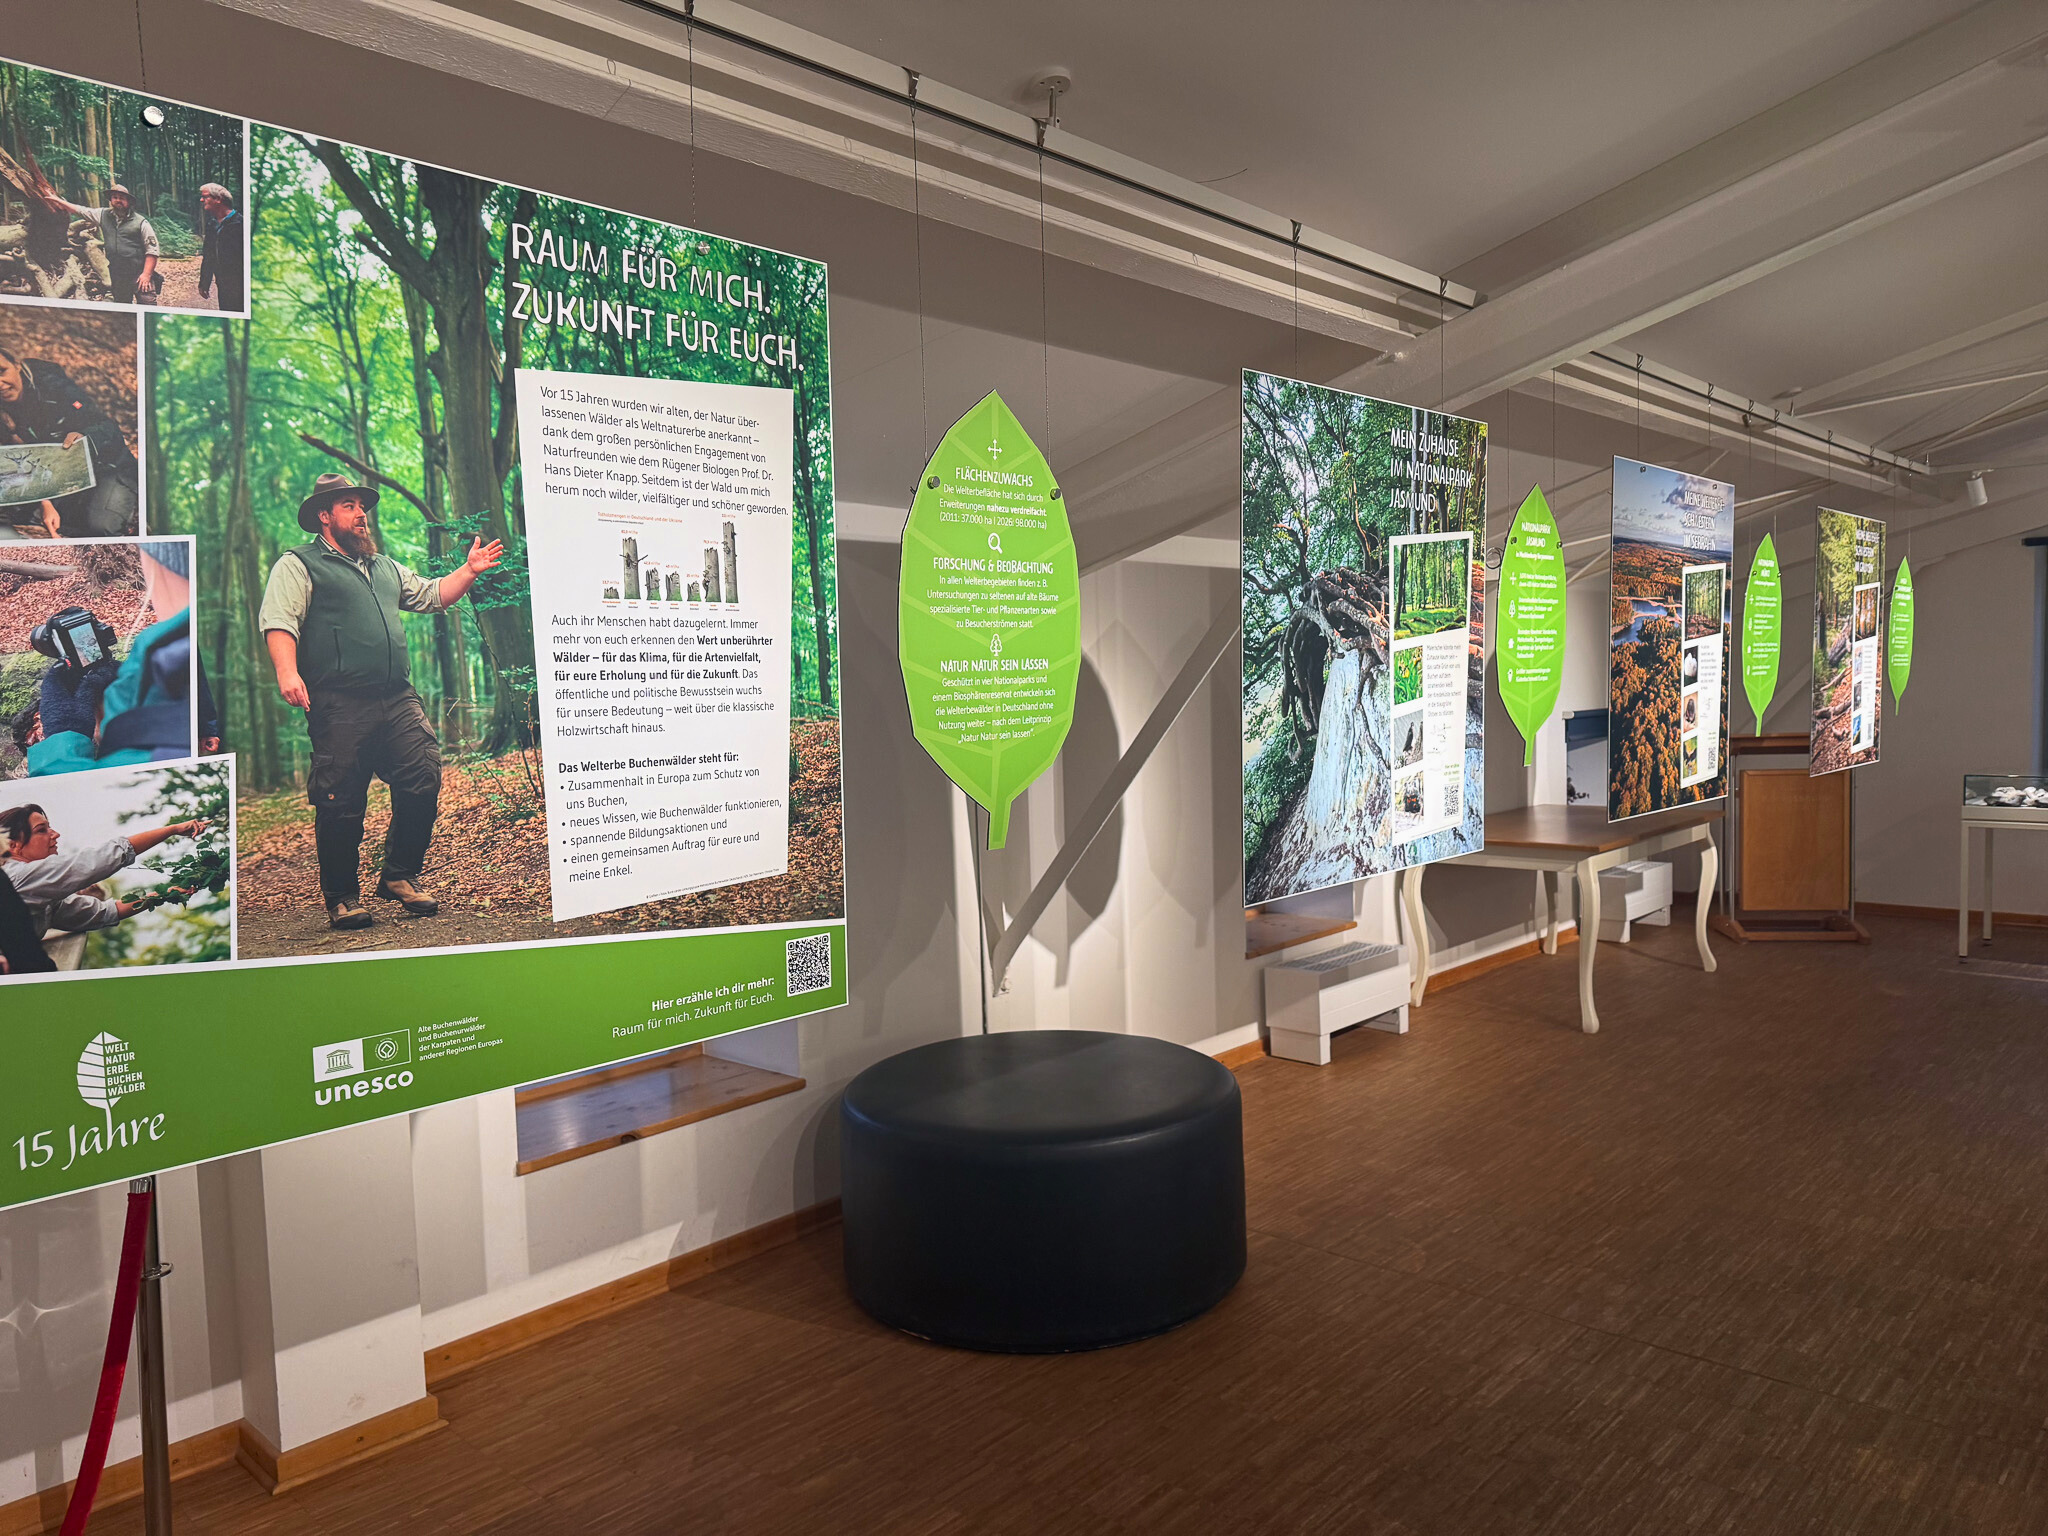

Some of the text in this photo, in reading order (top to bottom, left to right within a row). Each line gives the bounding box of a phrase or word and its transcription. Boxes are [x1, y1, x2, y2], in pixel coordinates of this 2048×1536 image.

[511, 223, 771, 314] RAUM FÜR MICH.
[511, 282, 804, 372] ZUKUNFT FÜR EUCH.
[540, 386, 759, 428] Vor 15 Jahren wurden wir alten, der Natur über-
[542, 405, 586, 422] lassenen
[588, 412, 623, 426] Wälder
[626, 418, 639, 428] als
[640, 419, 706, 438] Weltnaturerbe
[708, 431, 752, 444] anerkannt
[1390, 427, 1459, 457] MEIN ZUHAUSE
[955, 466, 1033, 487] FLÄCHENZUWACHS
[1390, 458, 1472, 488] IM NATIONALPARK
[546, 482, 788, 515] herum noch wilder, vielfältiger und schöner geworden.
[944, 484, 1044, 502] Die Welterbefläche hat sich durch
[1389, 488, 1436, 512] JASMUND
[940, 498, 1047, 516] Erweiterungen nahezu verdreifacht.
[934, 557, 1053, 574] FORSCHUNG & BEOBACHTUNG
[930, 604, 970, 615] spezialisierte
[971, 604, 985, 614] Tier-
[986, 606, 999, 614] und
[1000, 605, 1040, 614] Pflanzenarten
[552, 614, 758, 631] Auch ihr Menschen habt dazugelernt. Immer
[965, 618, 1018, 628] Besucherströmen
[1019, 620, 1034, 628] statt.
[553, 652, 590, 662] Wälder
[602, 652, 617, 662] für
[620, 652, 636, 662] das
[640, 652, 670, 664] Klima,
[672, 652, 686, 662] für
[688, 652, 702, 662] die
[704, 652, 760, 664] Artenvielfalt,
[940, 658, 1048, 672] NATUR NATUR SEIN LASSEN
[942, 675, 1047, 687] Geschützt in vier Nationalparks und
[557, 723, 665, 736] Holzwirtschaft hinaus.
[559, 752, 738, 773] Das Welterbe Buchenwälder steht für:
[568, 768, 760, 791] Zusammenhalt in Europa zum Schutz von
[566, 796, 627, 810] uns Buchen,
[570, 819, 727, 846] spannende Bildungsaktionen und
[570, 864, 632, 882] meine Enkel.
[652, 978, 774, 1011] Hier erzähle ich dir mehr:
[432, 1016, 478, 1030] Buchenwälder
[612, 993, 774, 1038] Raum für mich. Zukunft für Euch.
[418, 1024, 485, 1042] und Buchenurwälder
[431, 1038, 461, 1049] Karpaten
[462, 1034, 475, 1042] und
[105, 1042, 129, 1054] WELT
[419, 1039, 503, 1061] anderer Regionen Europas
[106, 1052, 135, 1064] NATUR
[107, 1063, 129, 1076] ERBE
[107, 1072, 143, 1086] BUCHEN
[314, 1070, 414, 1106] unesco
[108, 1082, 146, 1097] WÄLDER
[13, 1110, 166, 1171] 15 Jahre
